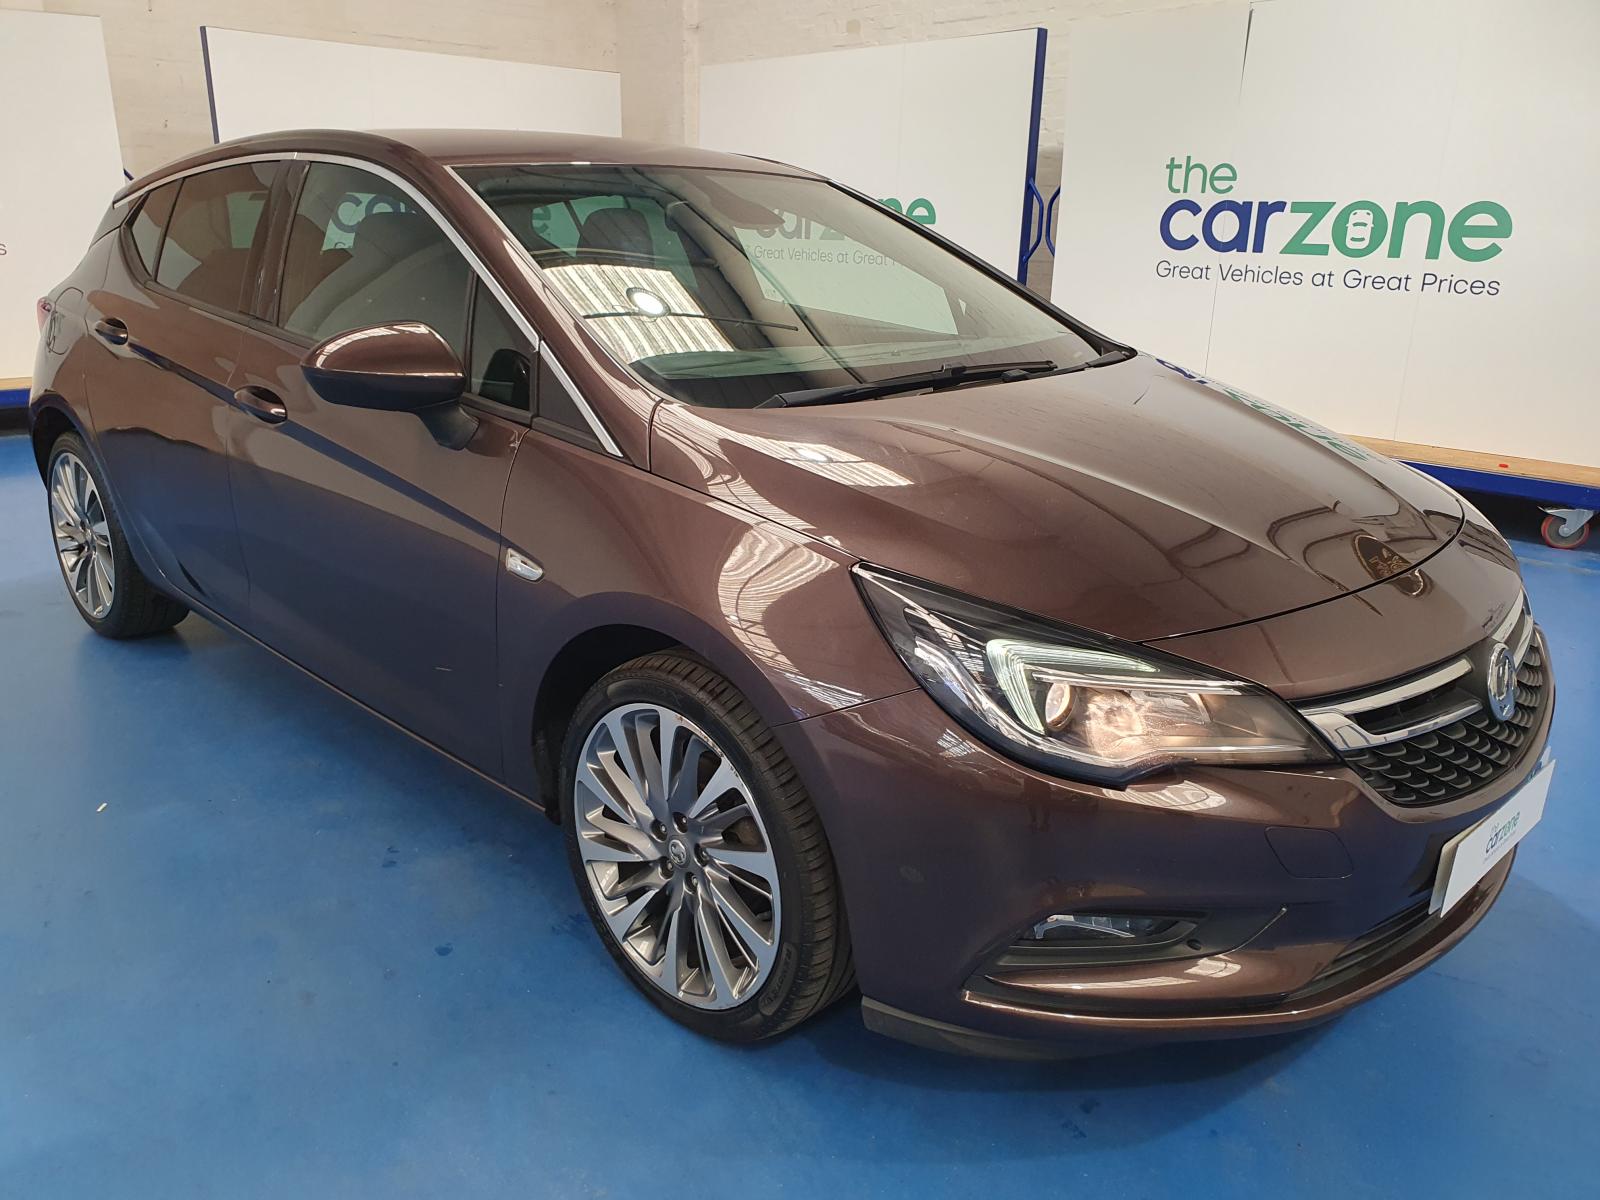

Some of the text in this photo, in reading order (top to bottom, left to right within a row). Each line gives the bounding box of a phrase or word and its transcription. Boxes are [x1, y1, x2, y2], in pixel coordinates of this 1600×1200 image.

[1166, 155, 1238, 194] the
[1159, 199, 1513, 263] carzone
[753, 245, 784, 260] Great
[787, 247, 834, 263] Vehicles
[836, 251, 850, 264] at
[1156, 260, 1501, 296] Great Vehicles at Great Prices
